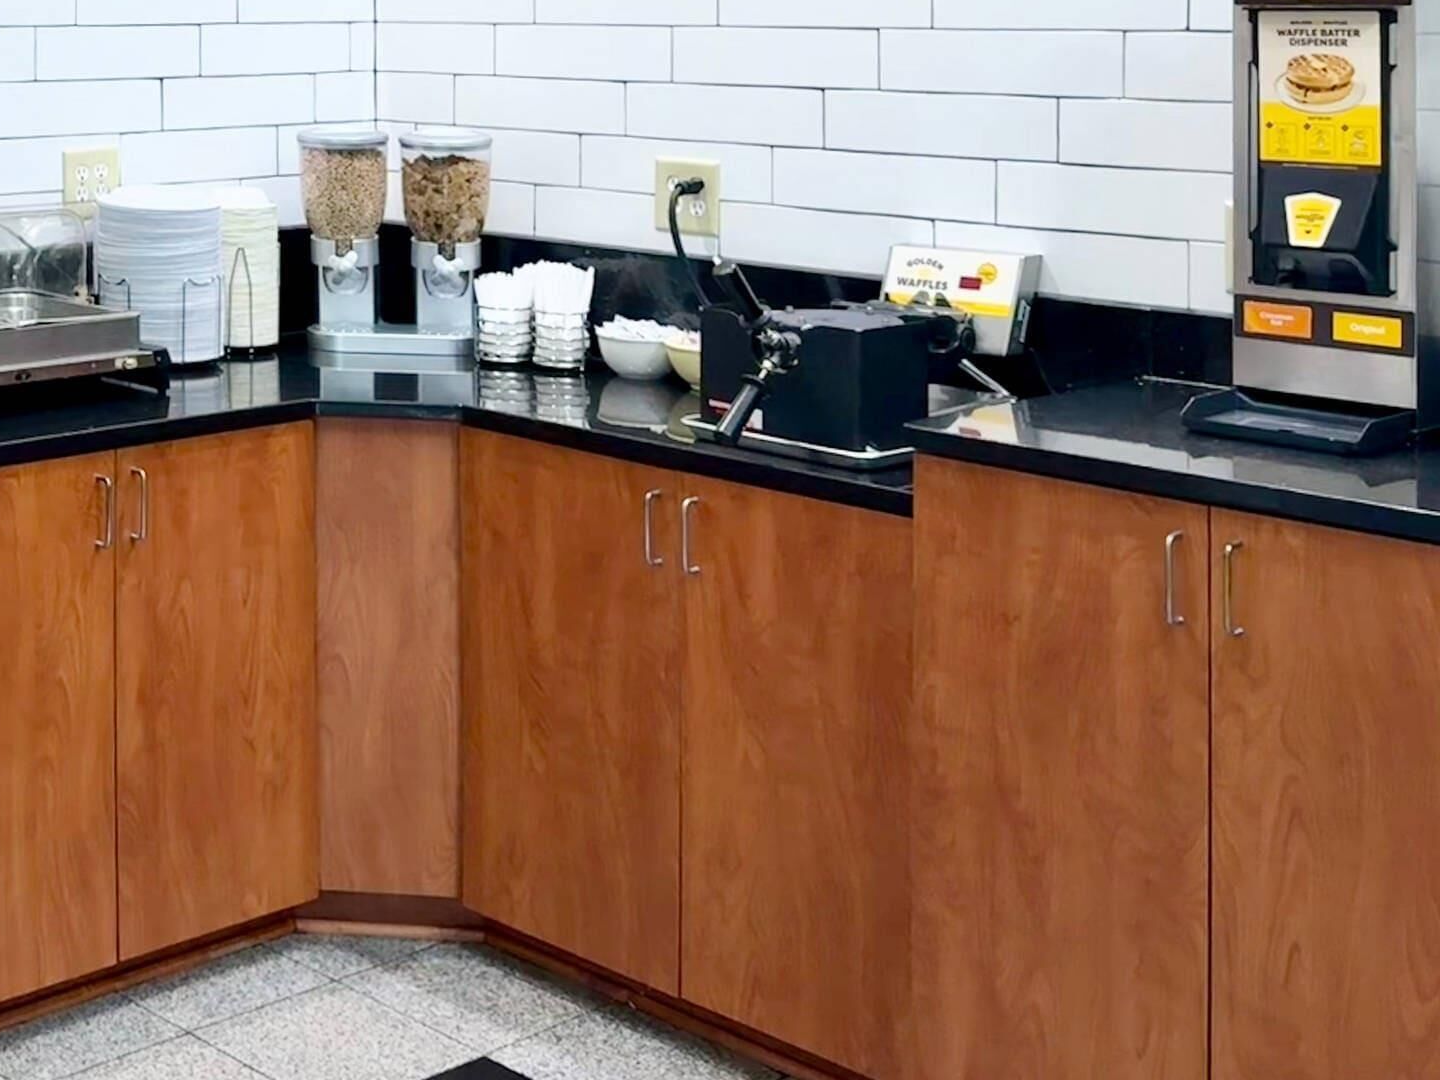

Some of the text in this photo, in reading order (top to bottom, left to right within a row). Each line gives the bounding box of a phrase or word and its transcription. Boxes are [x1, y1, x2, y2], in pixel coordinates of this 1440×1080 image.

[1276, 29, 1360, 37] WAFFLE BATTER
[1289, 38, 1348, 46] DISPENSER
[906, 258, 944, 270] GOLDEN
[897, 277, 948, 290] WAFFLES
